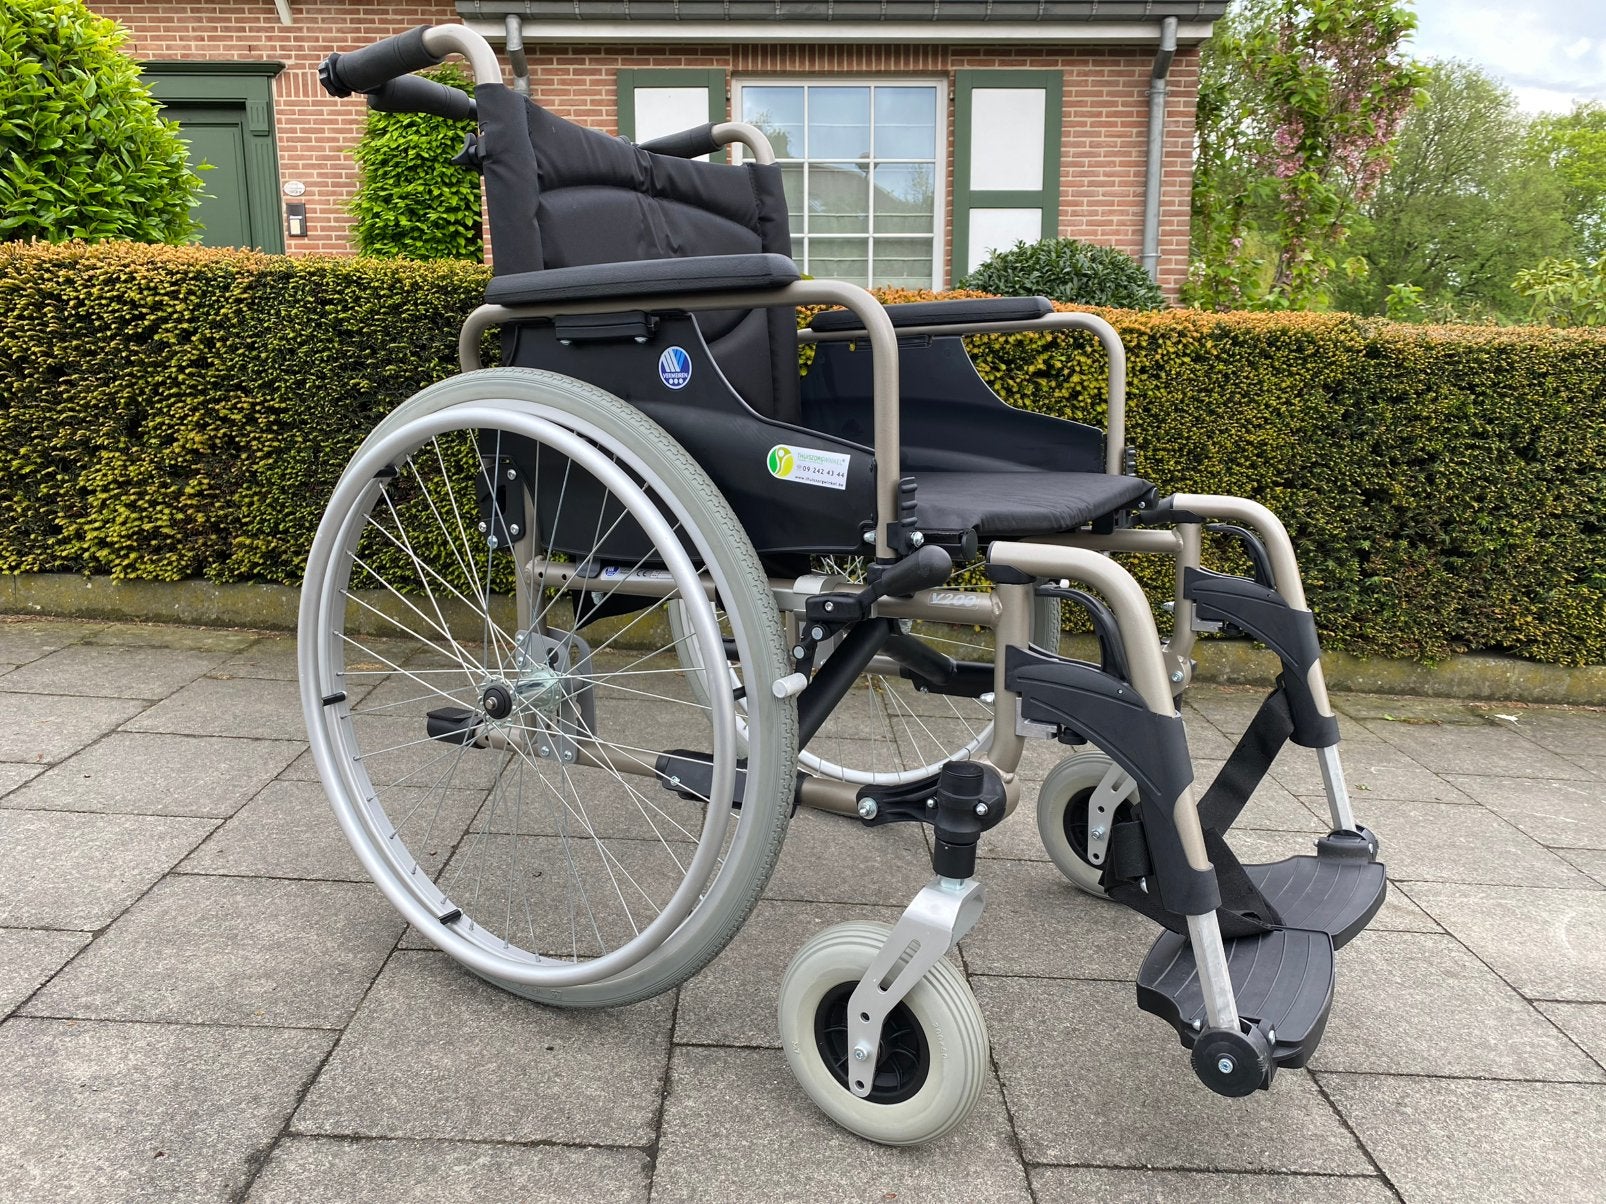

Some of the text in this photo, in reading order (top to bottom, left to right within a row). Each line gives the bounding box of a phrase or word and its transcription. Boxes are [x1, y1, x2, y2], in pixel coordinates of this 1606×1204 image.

[812, 467, 825, 475] 242
[826, 469, 835, 477] 43
[931, 592, 977, 607] V200
